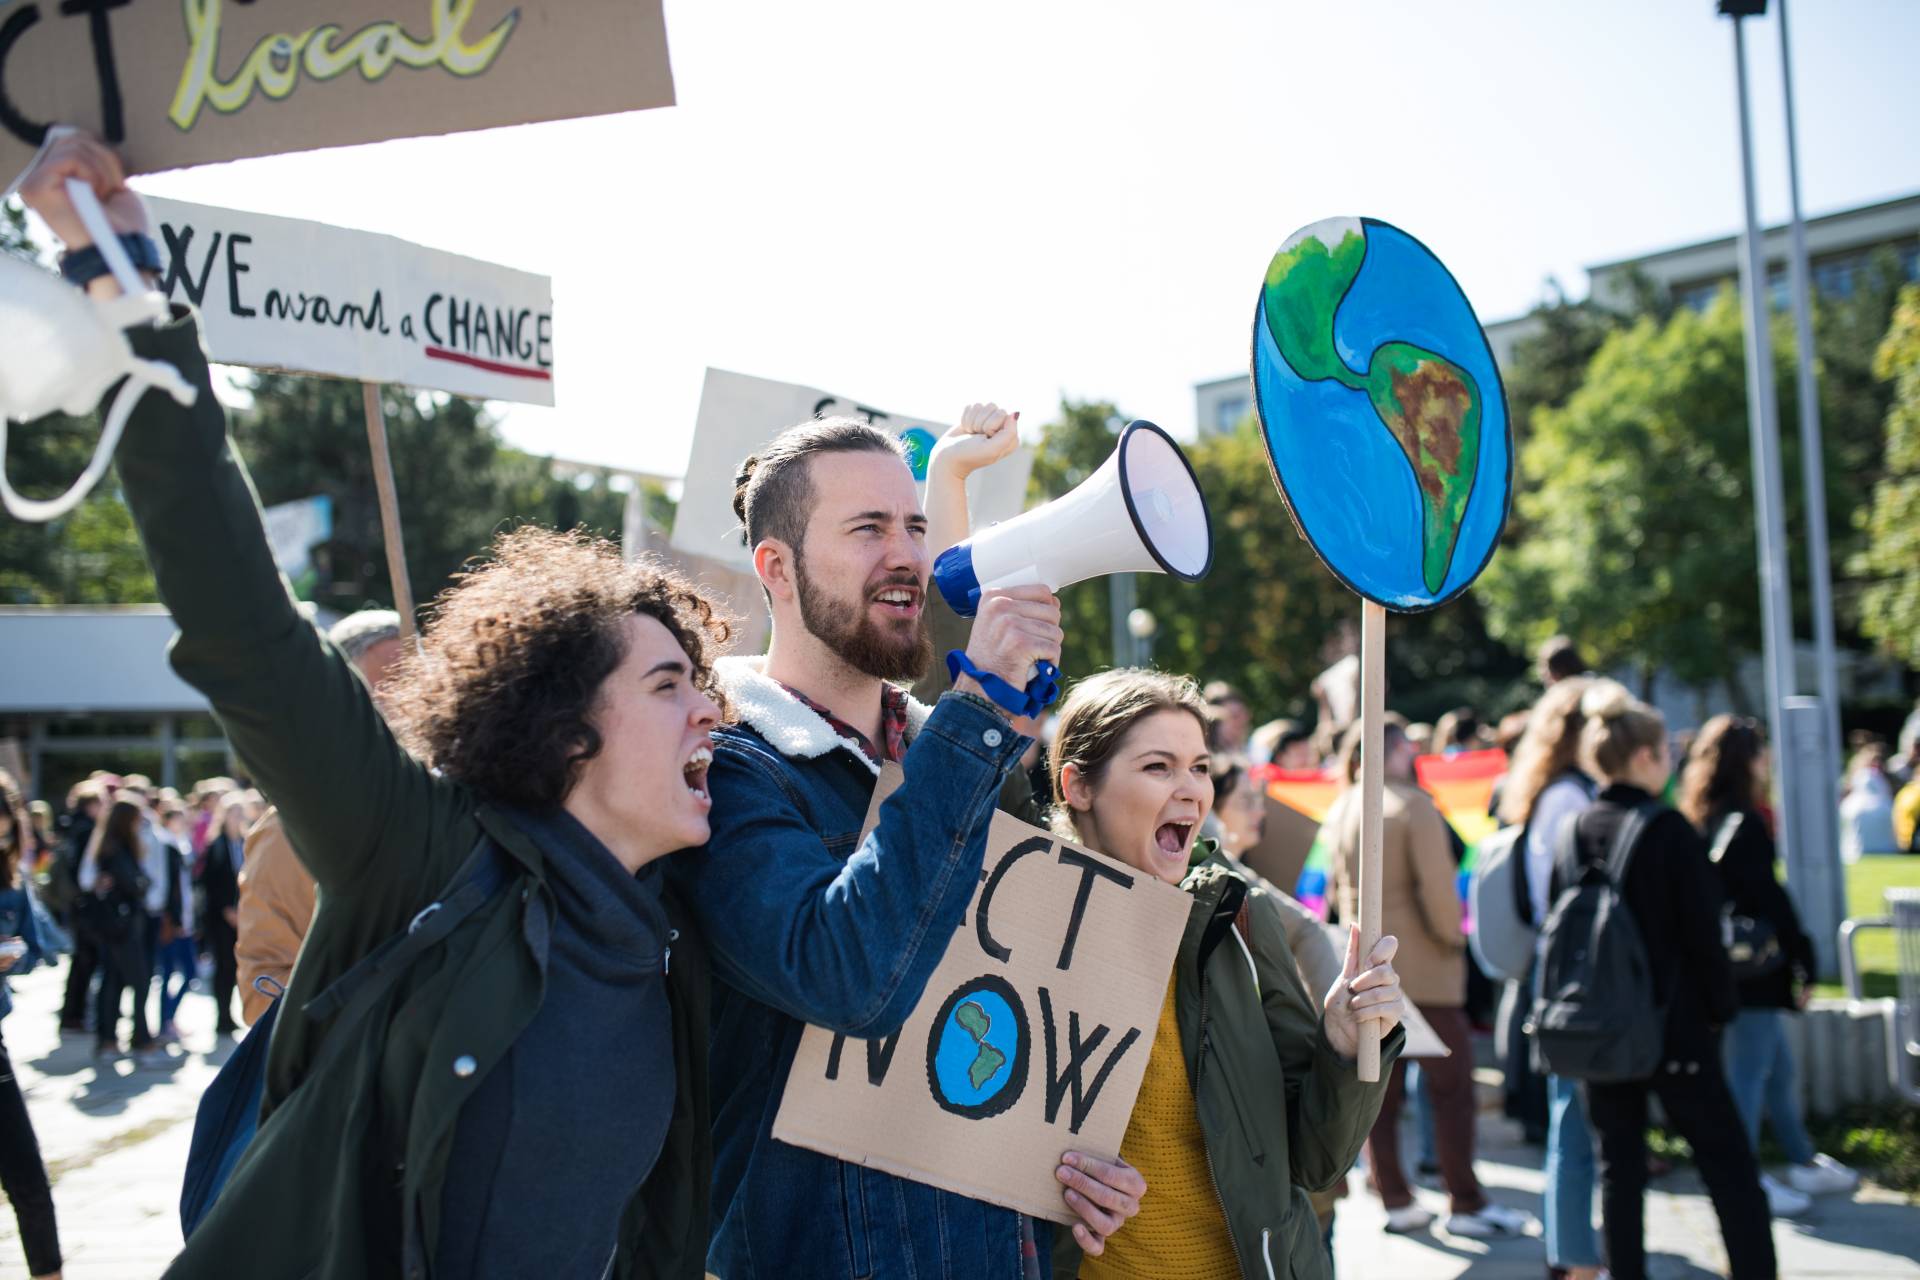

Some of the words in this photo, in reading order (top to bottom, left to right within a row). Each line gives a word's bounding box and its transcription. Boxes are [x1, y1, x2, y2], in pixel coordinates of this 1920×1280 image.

[168, 0, 521, 132] local
[158, 223, 256, 317] WE
[264, 288, 390, 337] want
[401, 314, 418, 342] a
[424, 293, 552, 367] CHANGE
[961, 836, 1134, 970] CT
